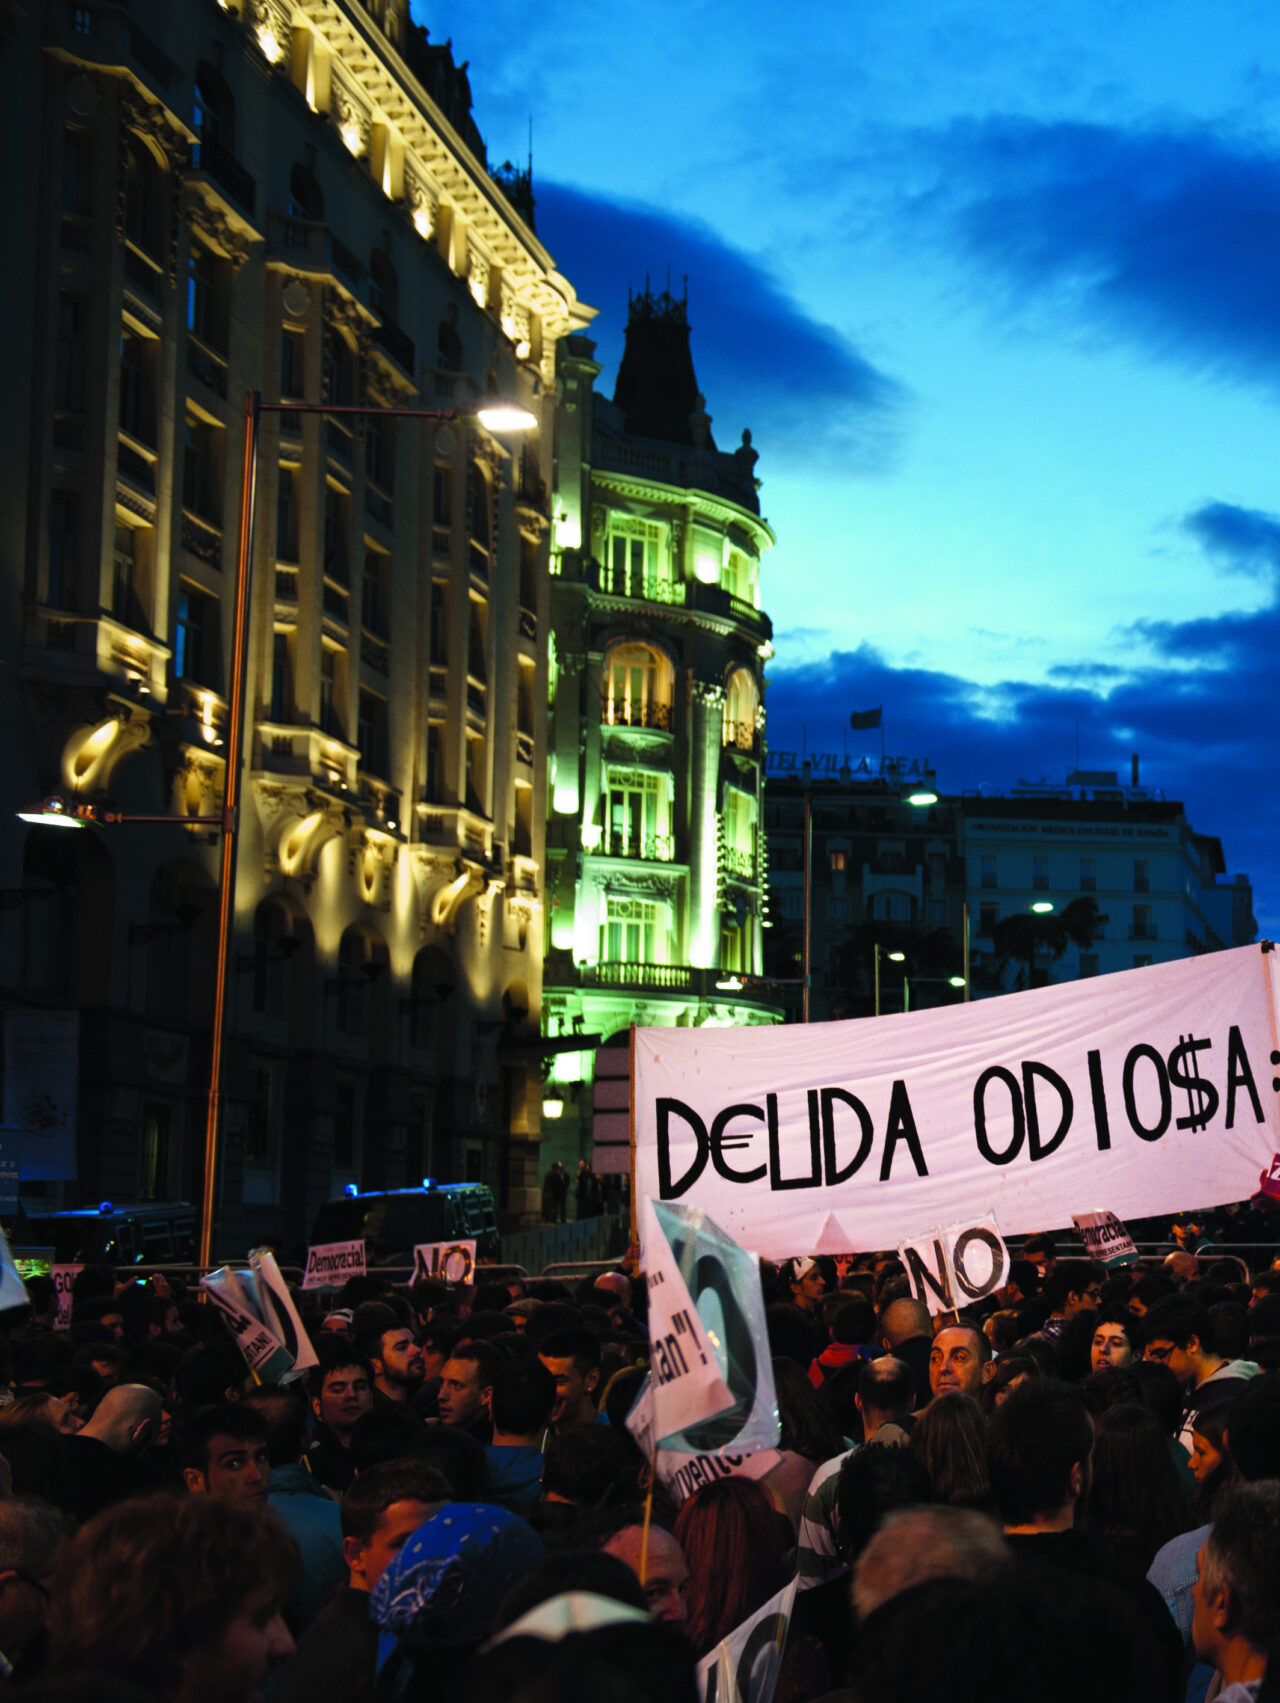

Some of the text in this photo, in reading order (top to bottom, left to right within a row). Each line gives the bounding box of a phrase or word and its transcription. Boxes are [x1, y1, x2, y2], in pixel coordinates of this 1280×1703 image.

[308, 1243, 364, 1274] Democracia!
[416, 1245, 471, 1283] NO
[904, 1227, 1003, 1310] NO
